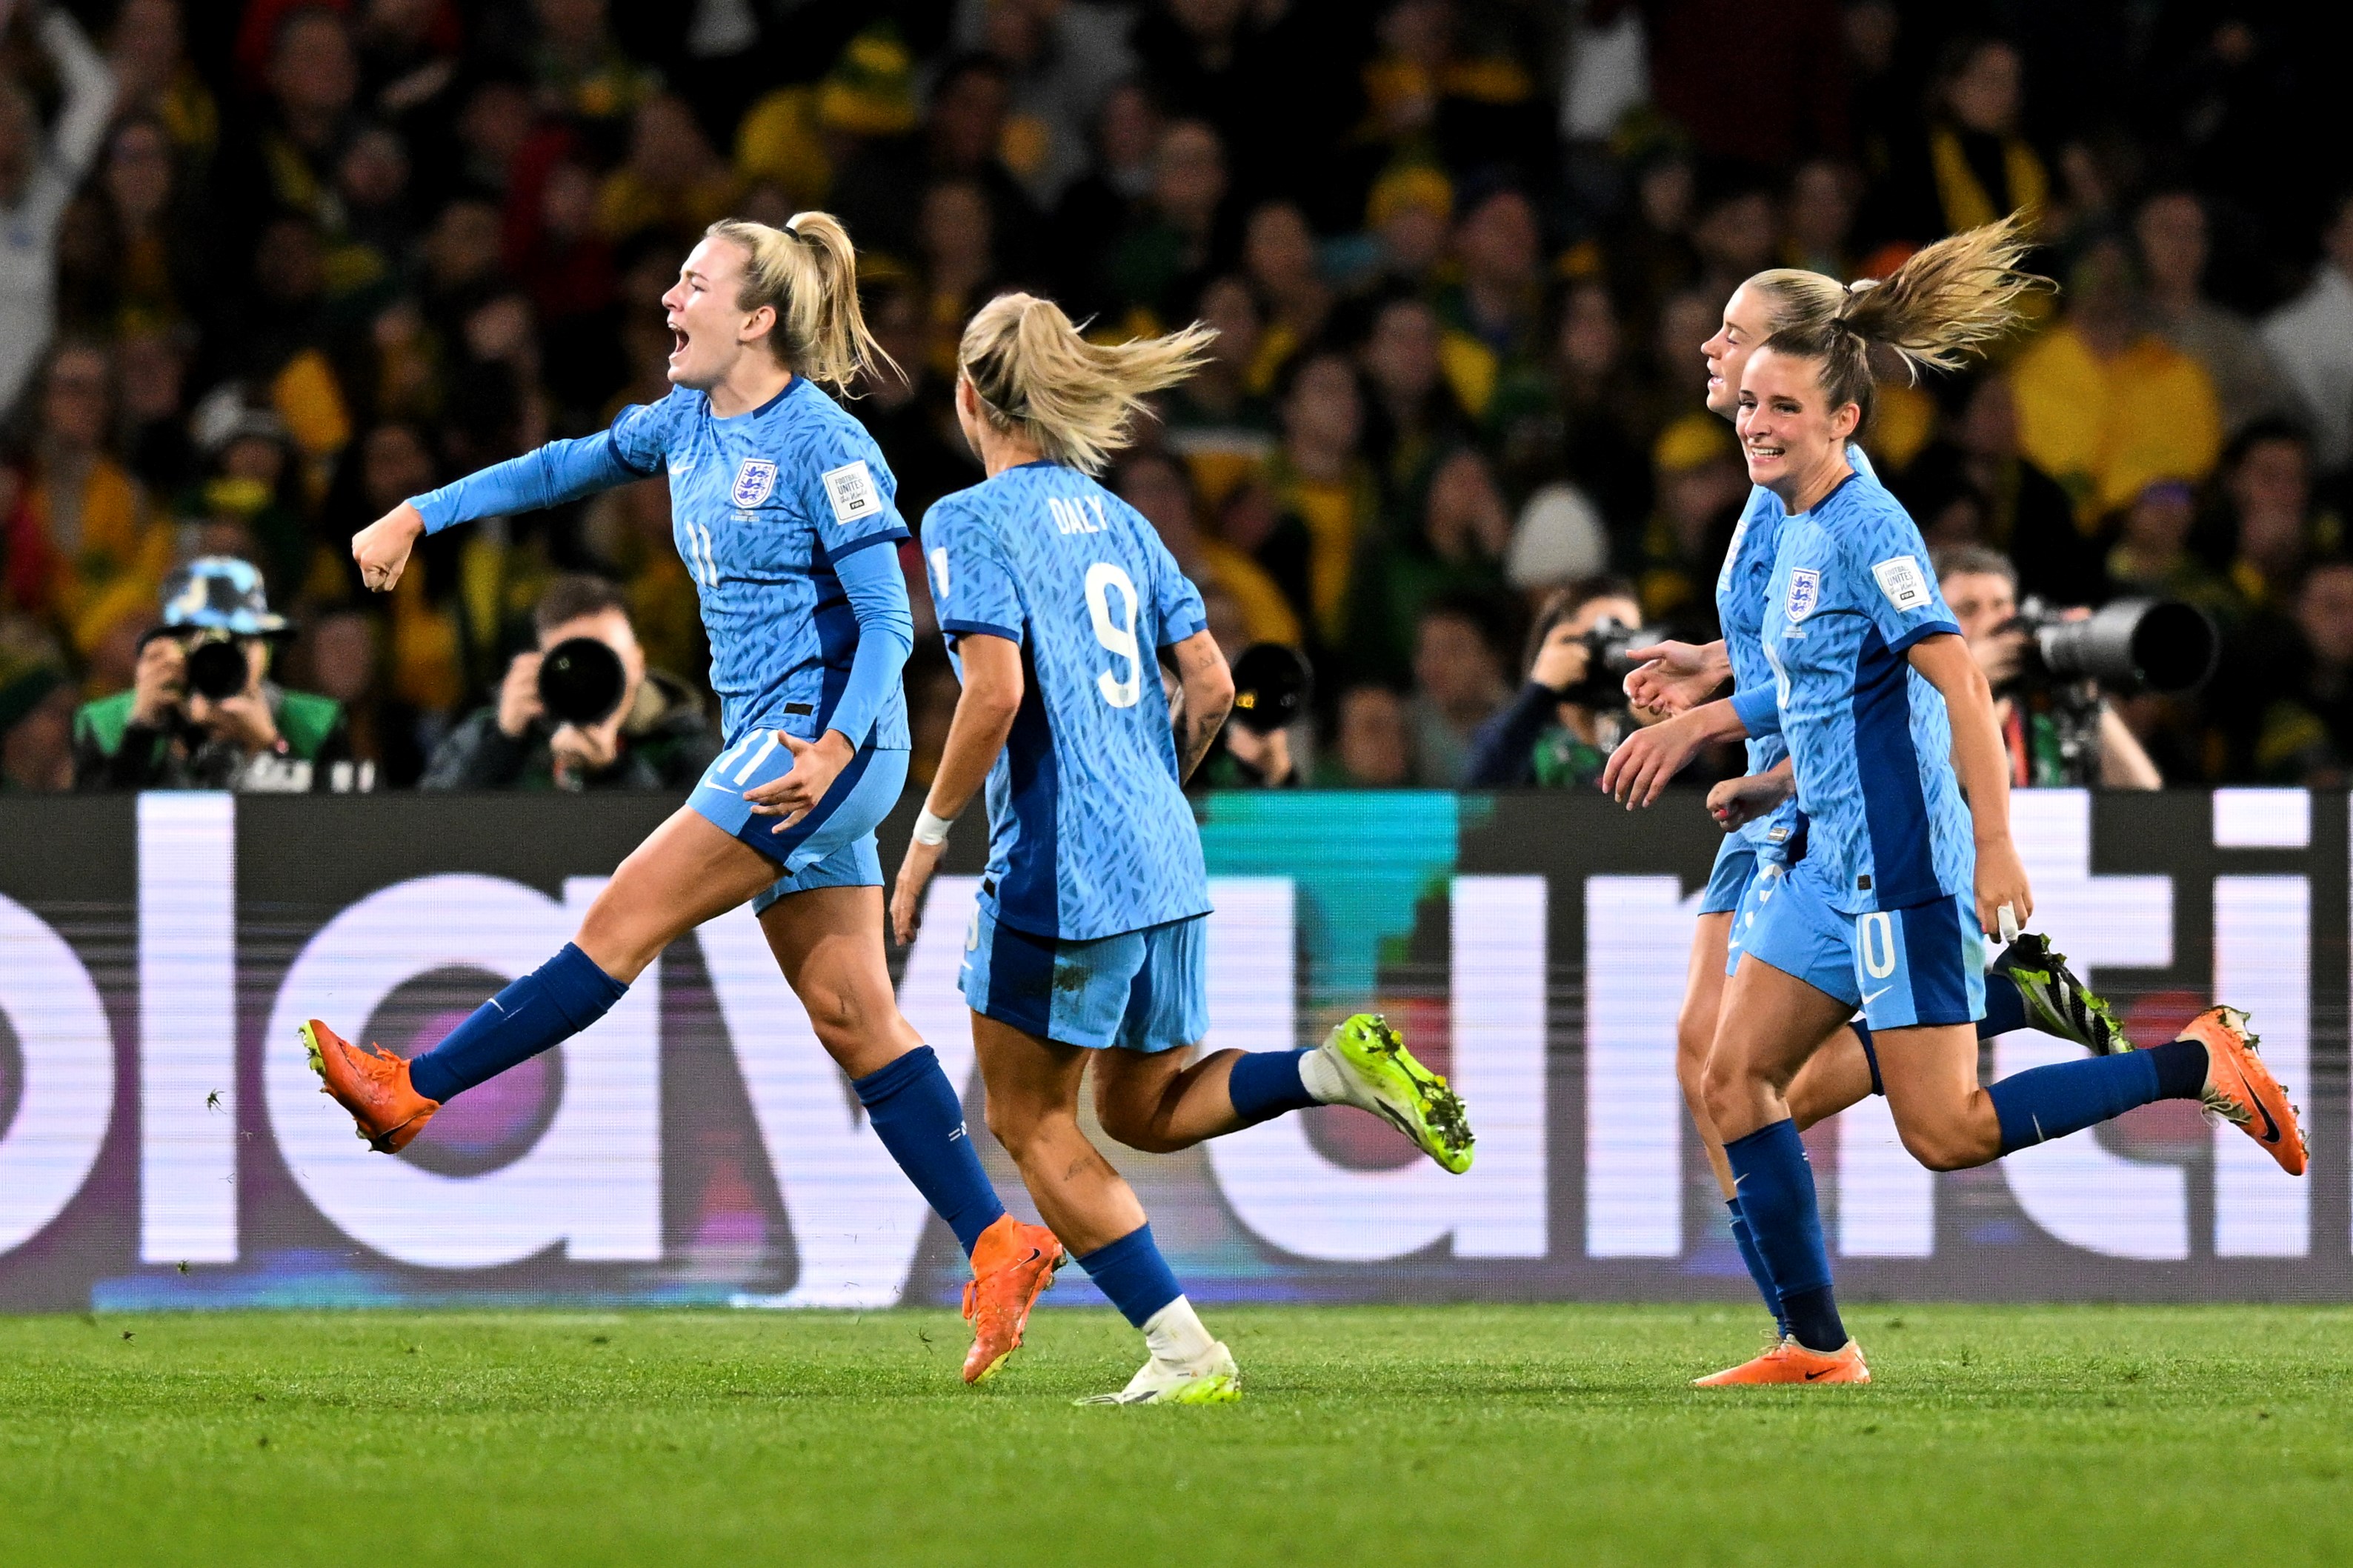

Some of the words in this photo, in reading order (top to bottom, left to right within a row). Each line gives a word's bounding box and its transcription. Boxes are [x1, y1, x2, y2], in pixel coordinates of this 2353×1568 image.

[837, 478, 864, 495] UNITES
[1048, 496, 1108, 535] DALY
[685, 521, 719, 588] 11
[1887, 571, 1913, 586] UNITES
[1085, 562, 1140, 708] 9
[716, 728, 779, 787] 11
[1855, 911, 1895, 978] 10
[0, 790, 985, 1308] lay
[1199, 787, 2353, 1261] unti
